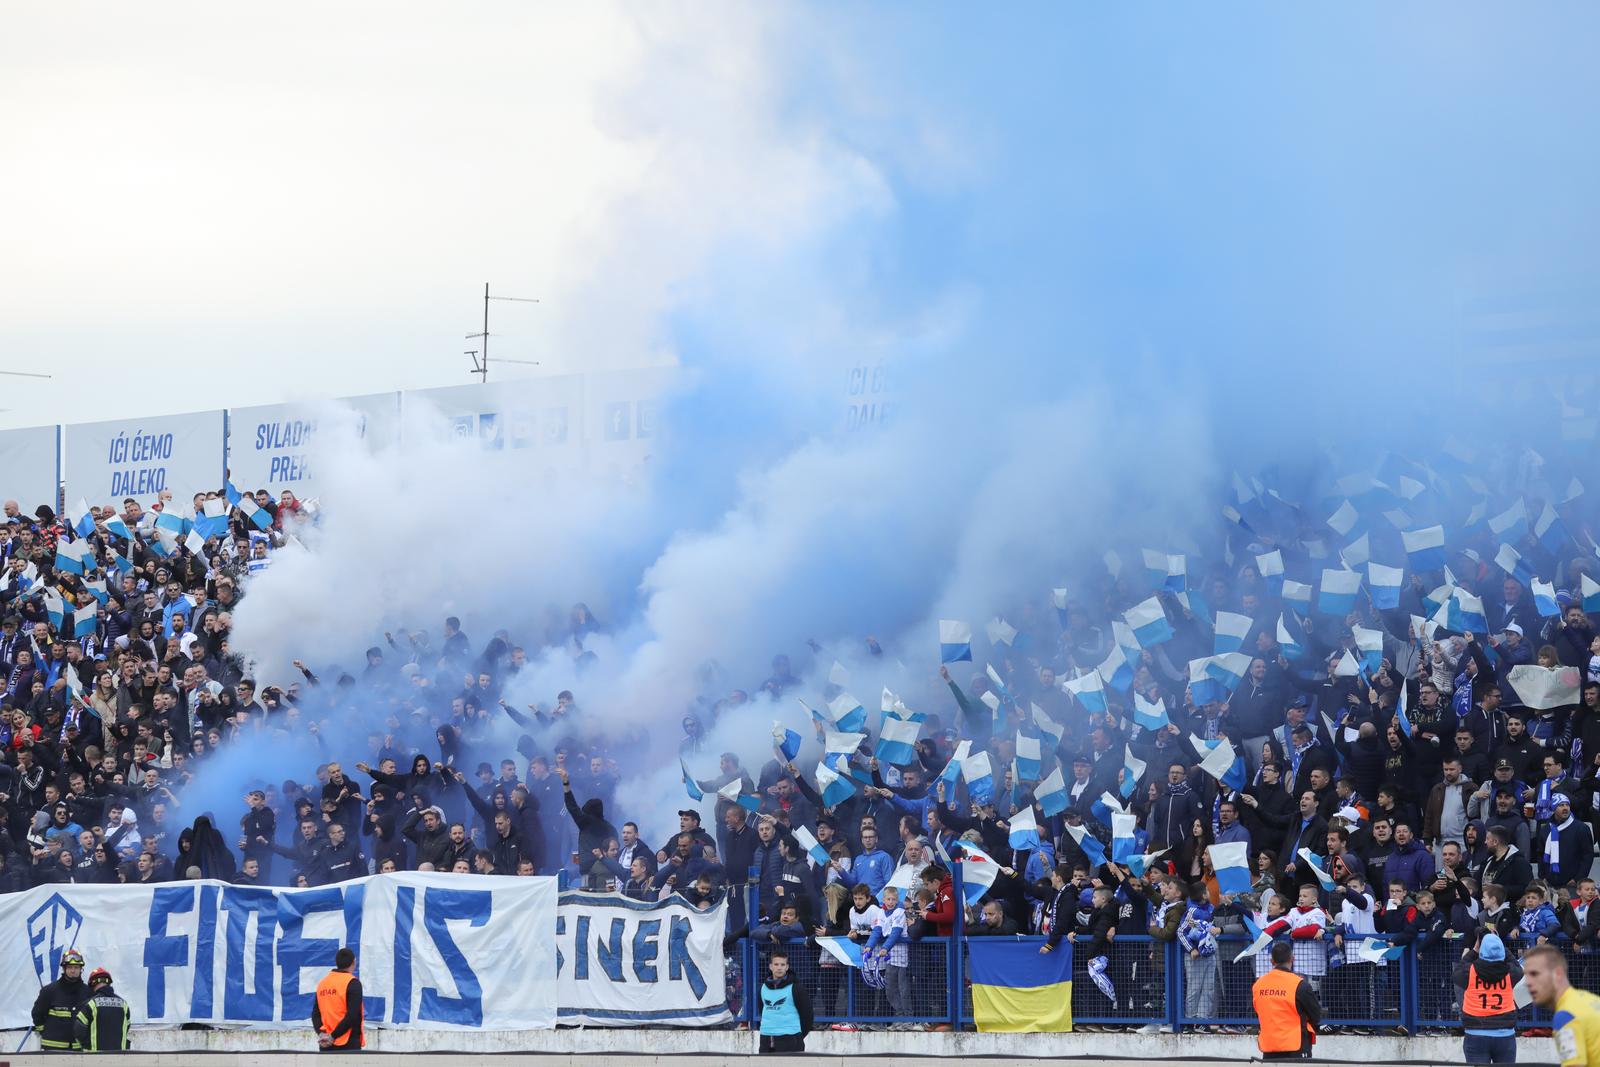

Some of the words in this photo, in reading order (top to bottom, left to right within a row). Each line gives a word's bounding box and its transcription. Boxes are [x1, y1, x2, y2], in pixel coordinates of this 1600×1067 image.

[109, 431, 129, 464] IĆI
[131, 429, 173, 462] ĆEMO
[111, 467, 168, 497] DALEKO.
[1259, 989, 1287, 997] REDAR
[1478, 993, 1503, 1010] 12
